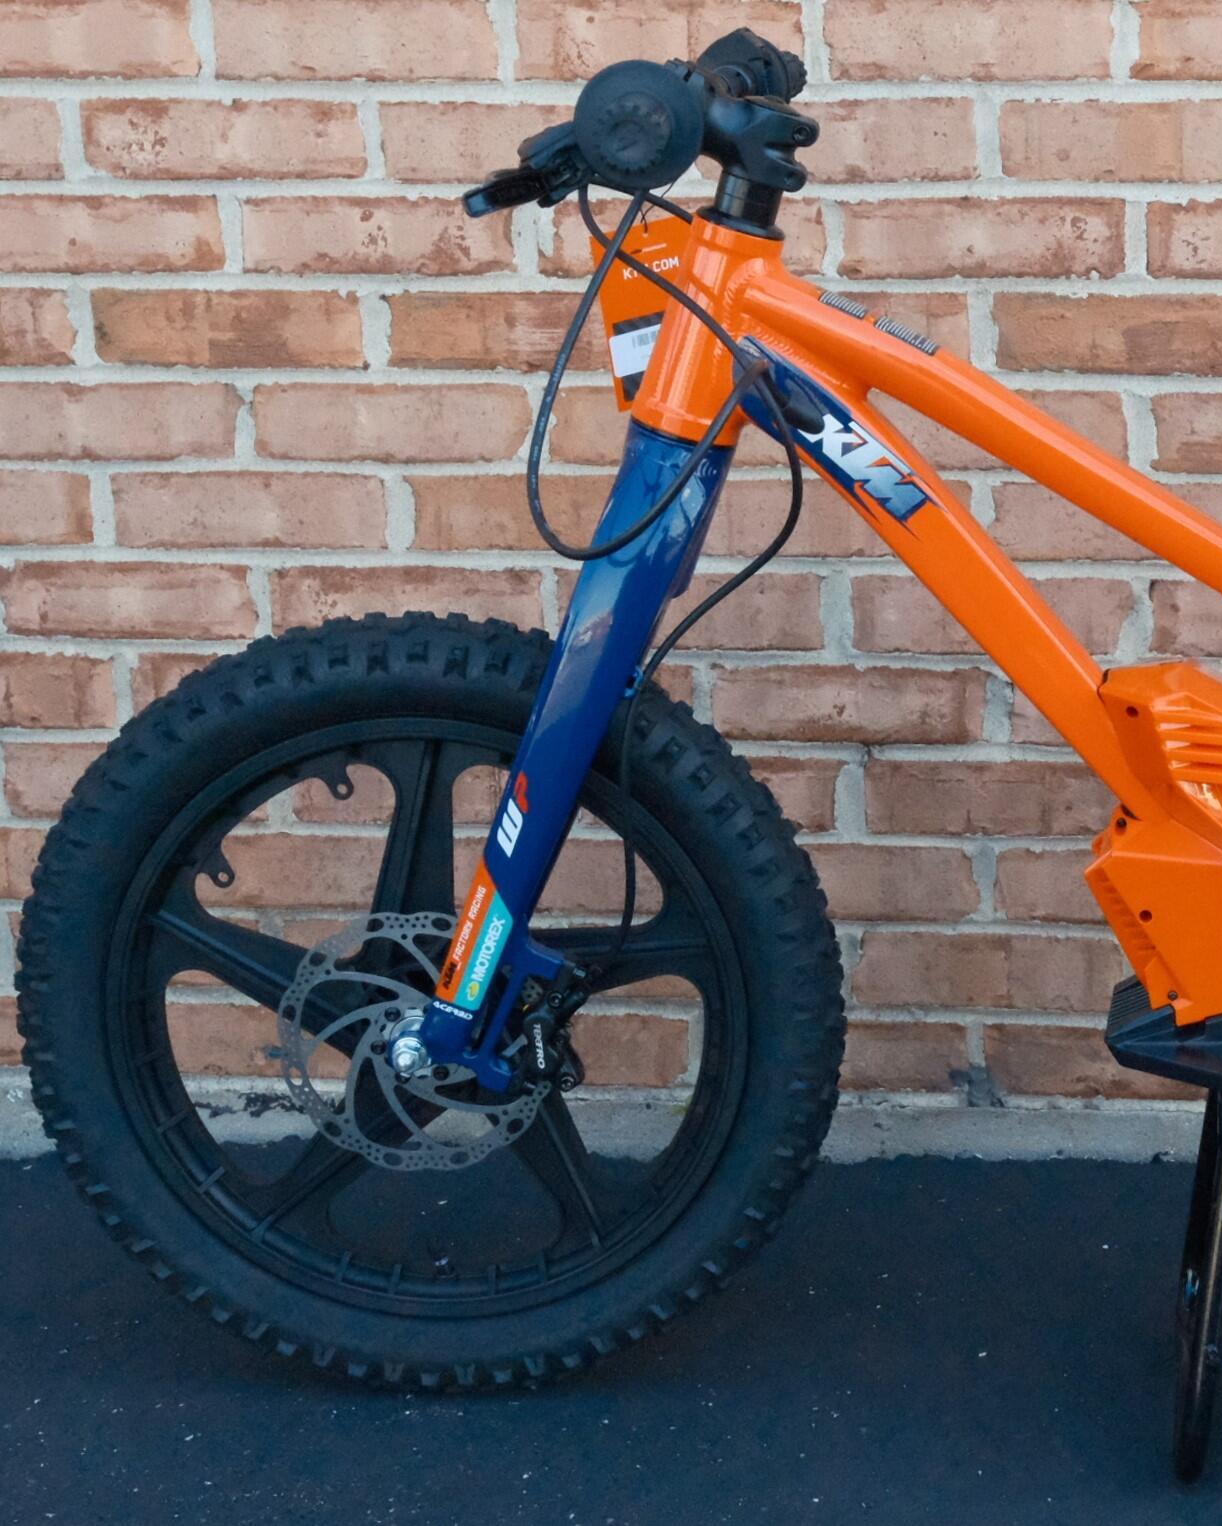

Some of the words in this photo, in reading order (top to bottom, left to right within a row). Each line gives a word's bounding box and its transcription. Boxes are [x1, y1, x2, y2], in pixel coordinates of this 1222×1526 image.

[623, 256, 680, 280] KTCOM
[797, 413, 927, 517] KTM
[468, 885, 487, 920] RACING
[471, 915, 506, 981] MOTOREX
